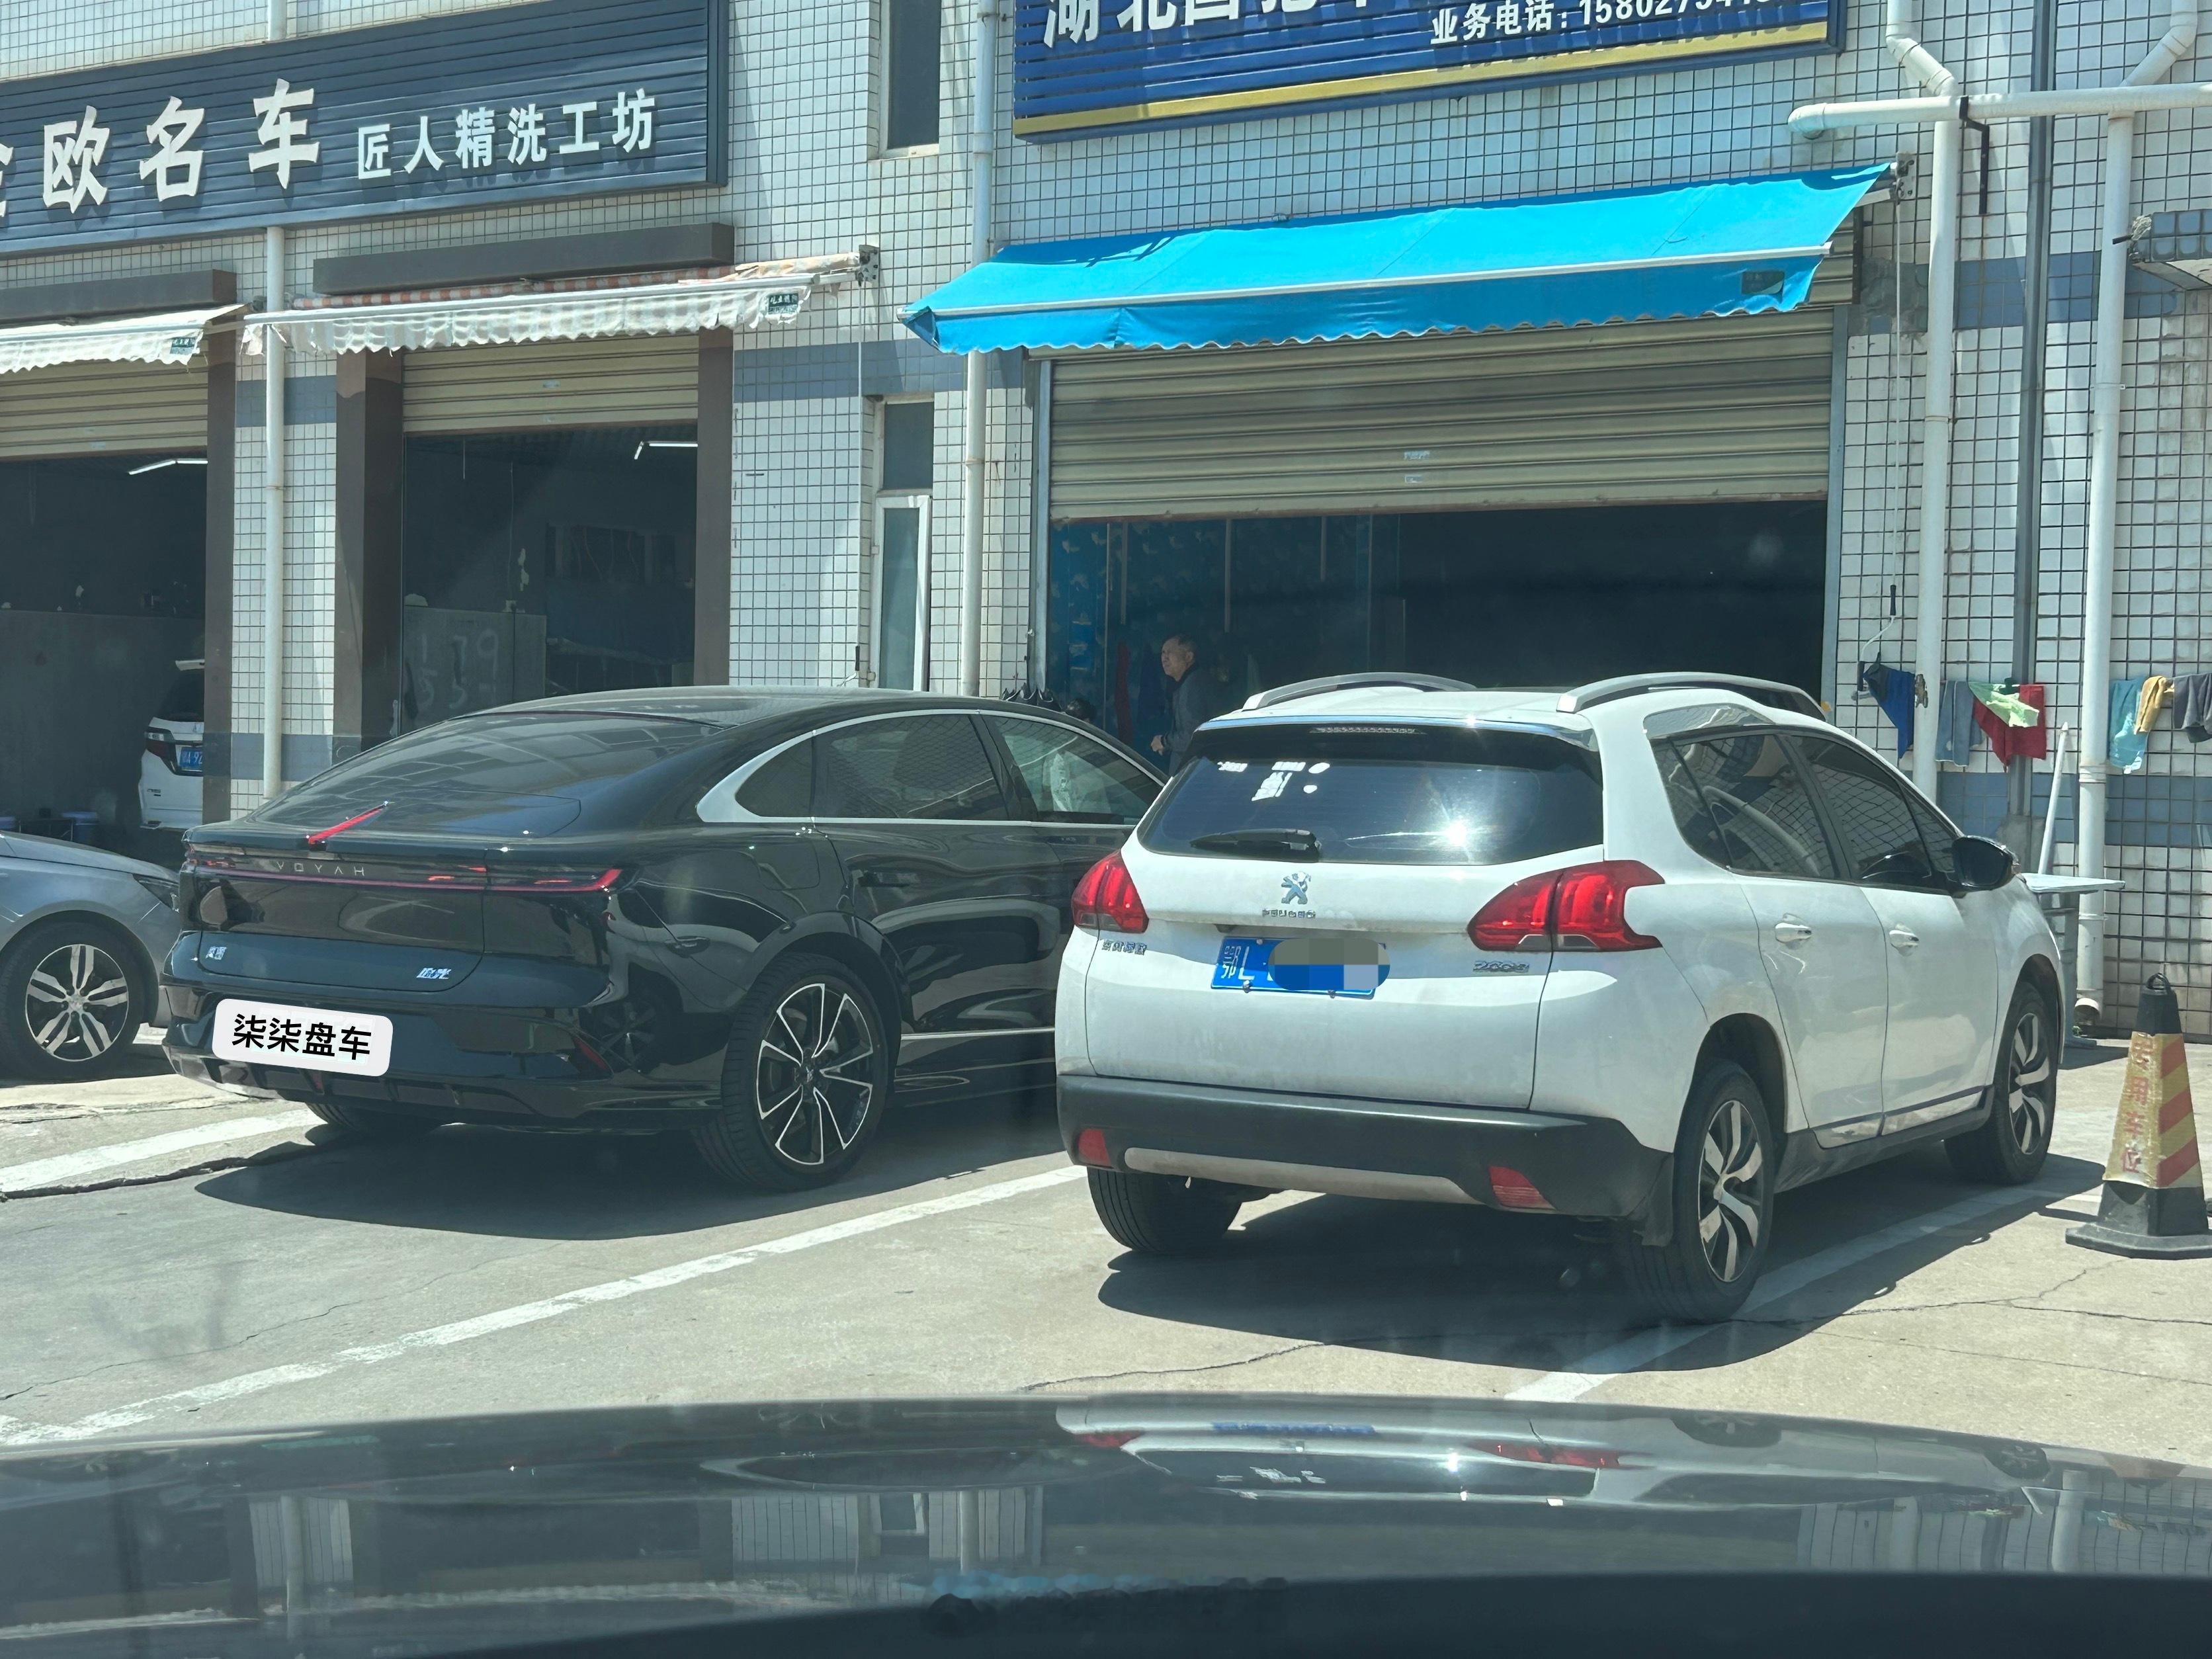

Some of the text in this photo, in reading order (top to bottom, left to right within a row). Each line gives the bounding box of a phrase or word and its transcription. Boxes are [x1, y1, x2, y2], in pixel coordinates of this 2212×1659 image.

[0, 78, 320, 218] 欧名车
[357, 88, 656, 180] 匠人精洗工坊
[276, 861, 365, 876] VOYAH
[1261, 909, 1317, 919] PEUGEO
